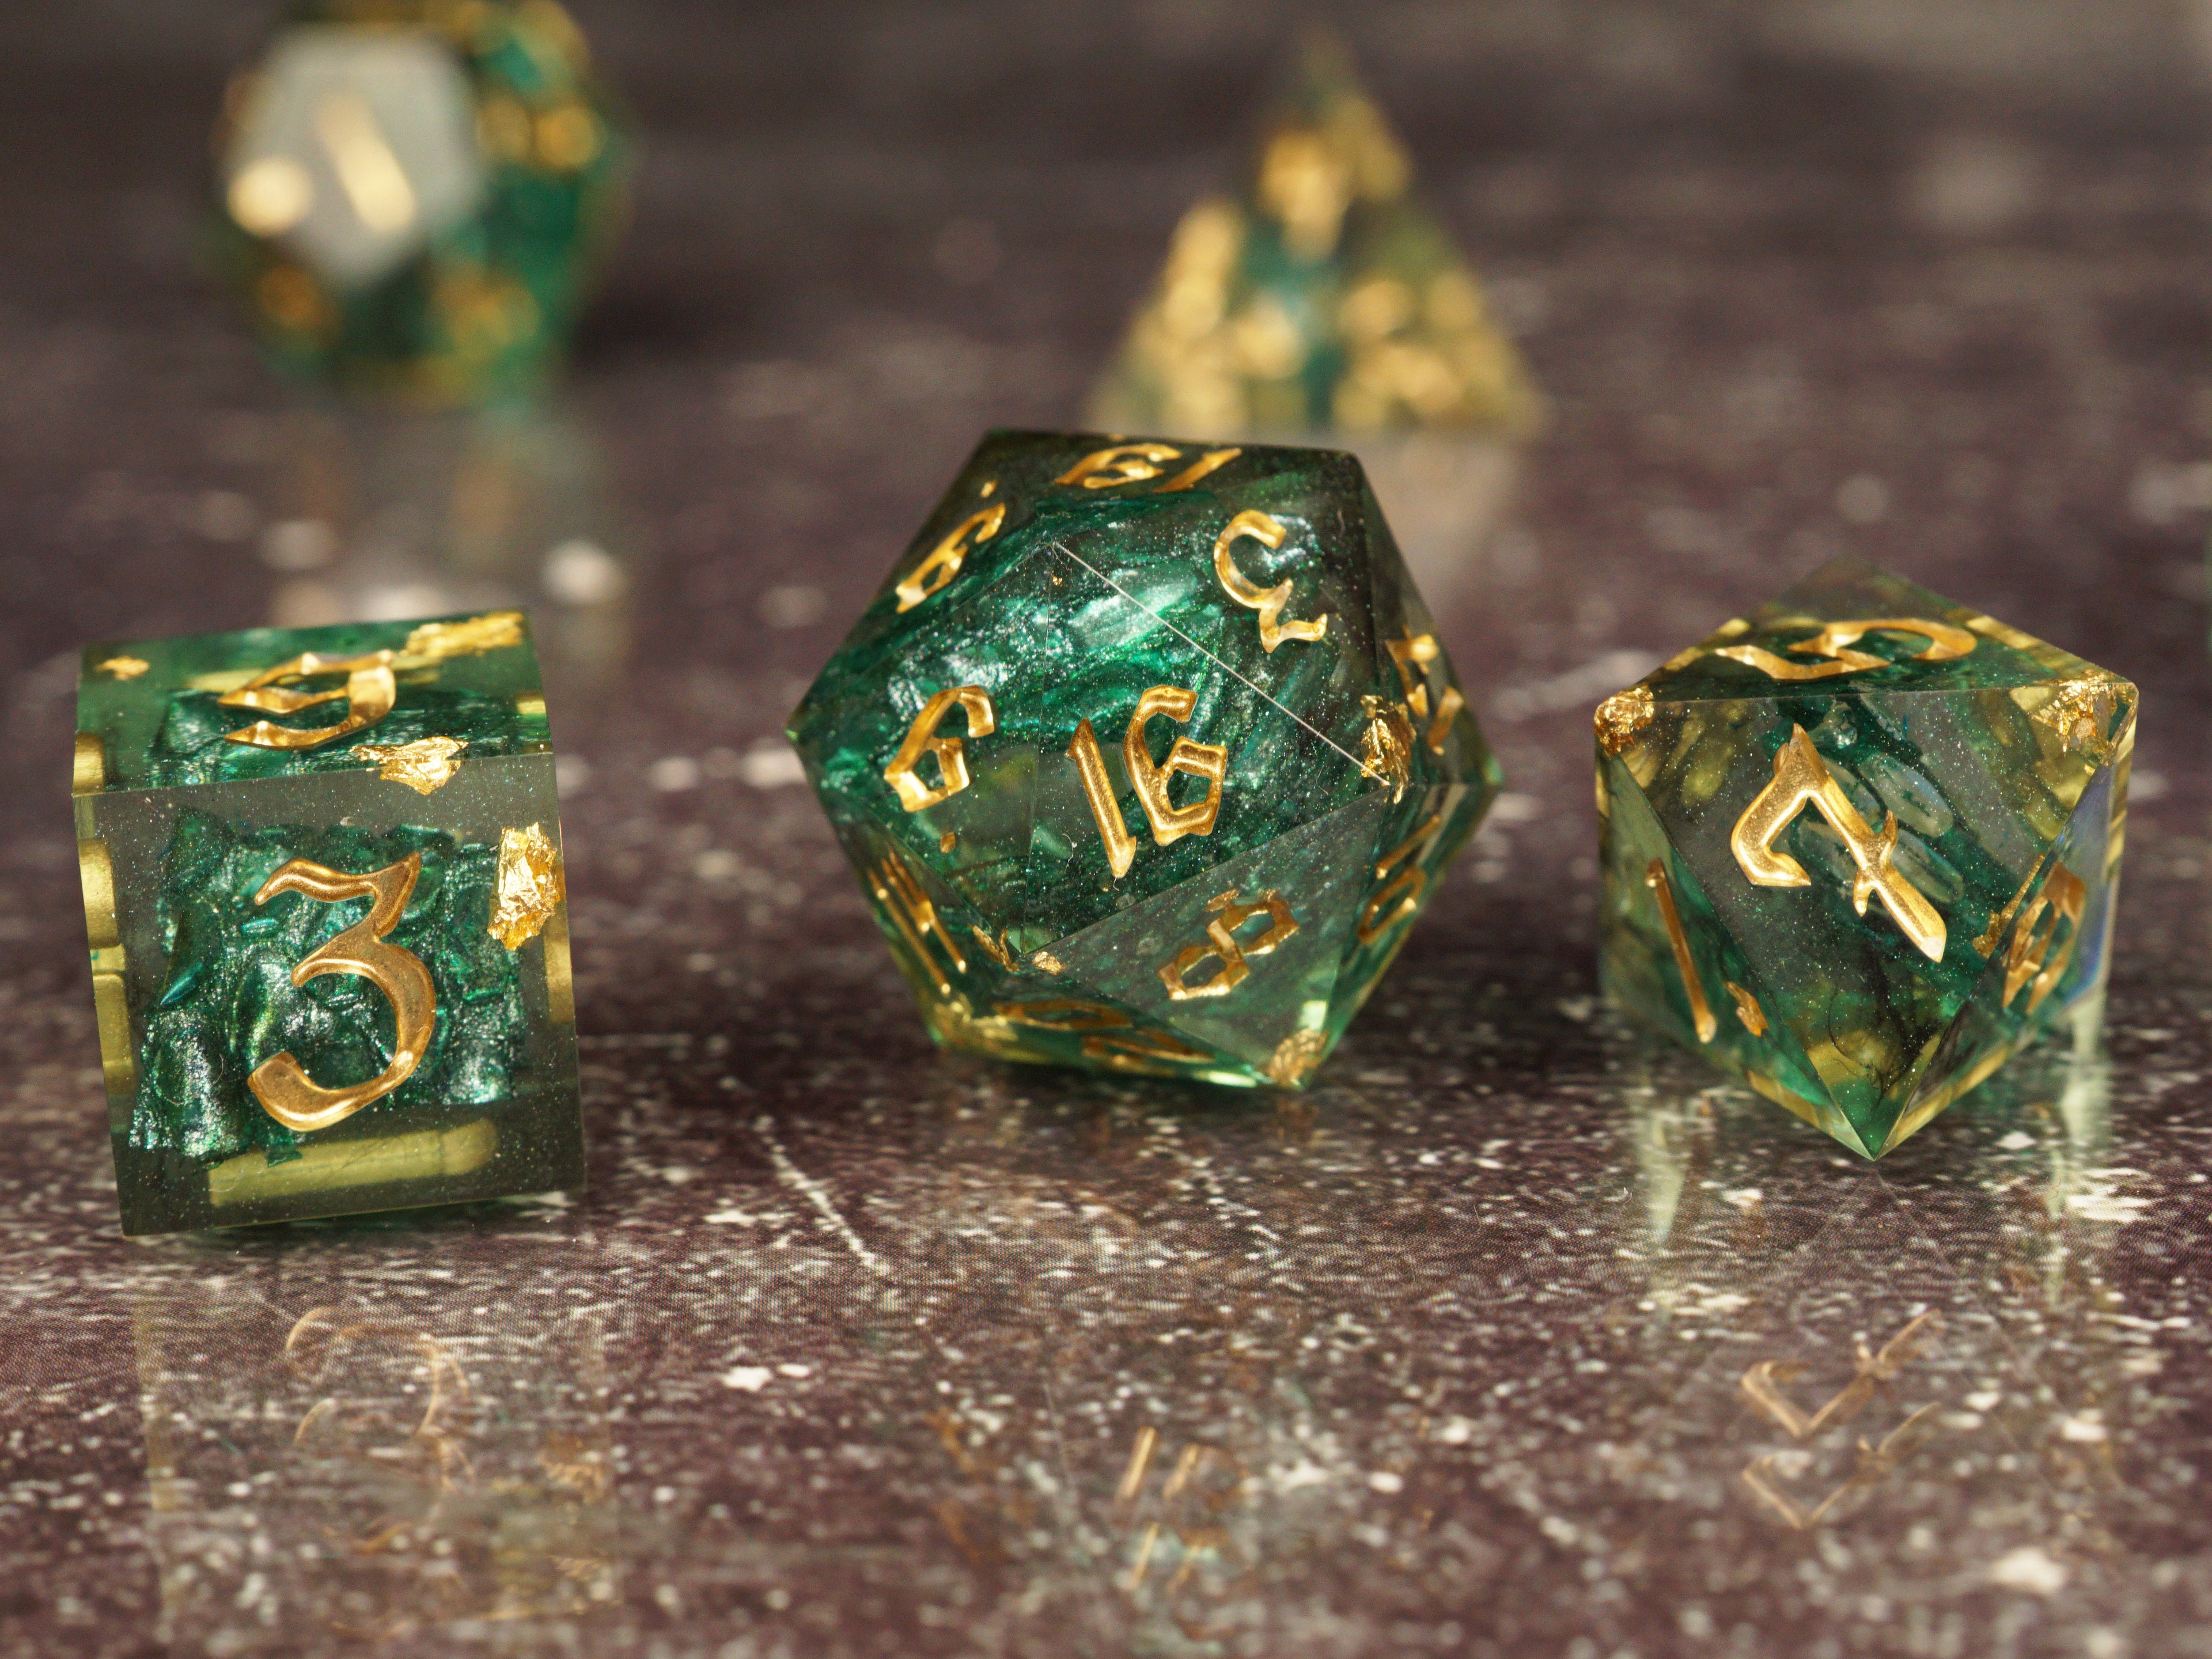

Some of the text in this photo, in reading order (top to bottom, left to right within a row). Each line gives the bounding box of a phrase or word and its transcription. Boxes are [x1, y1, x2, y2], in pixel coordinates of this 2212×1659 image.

[1066, 685, 1228, 878] 16
[1731, 723, 1947, 962] 7
[247, 852, 436, 1131] 3
[1156, 900, 1300, 1001] 8
